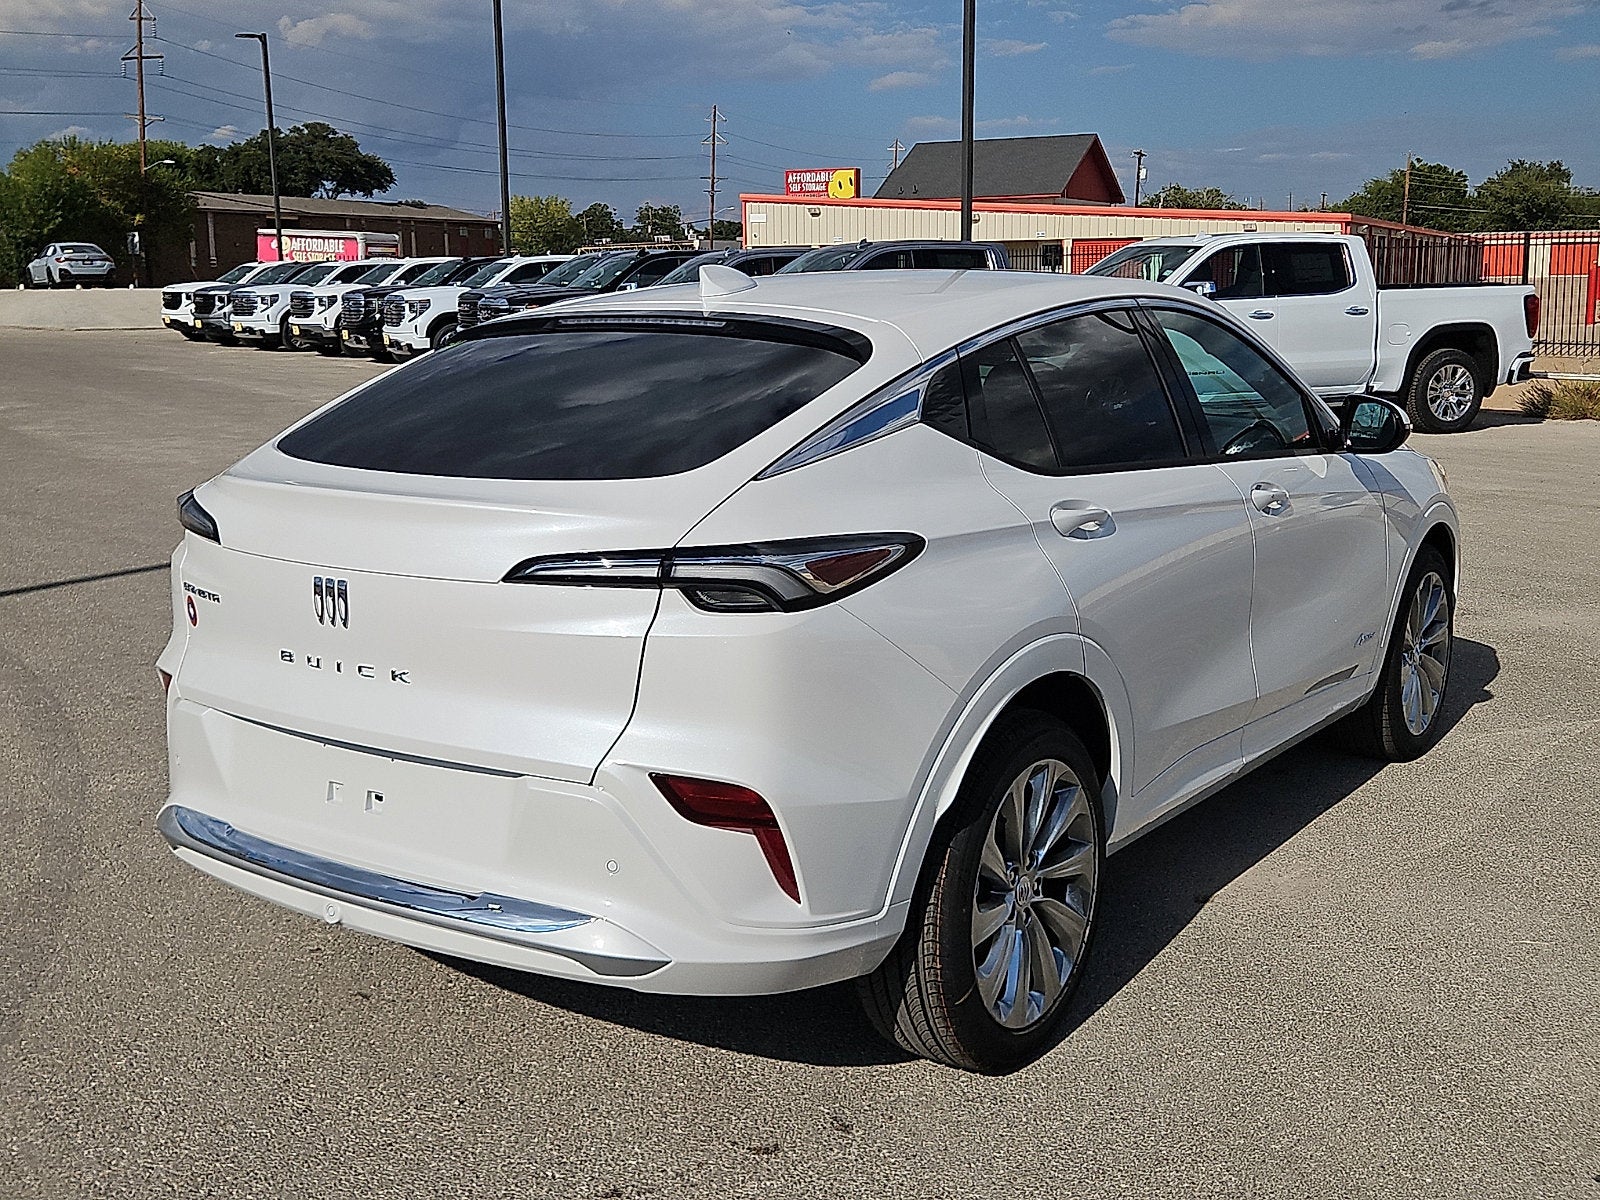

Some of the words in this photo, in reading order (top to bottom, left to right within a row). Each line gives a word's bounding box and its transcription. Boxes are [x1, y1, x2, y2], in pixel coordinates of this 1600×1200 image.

[788, 172, 833, 183] AFFORDABLE
[789, 183, 801, 192] SELF
[802, 182, 826, 192] STORAGE
[291, 237, 345, 253] AFFORDABLE
[293, 251, 307, 262] SELF
[280, 649, 411, 684] BUICK
